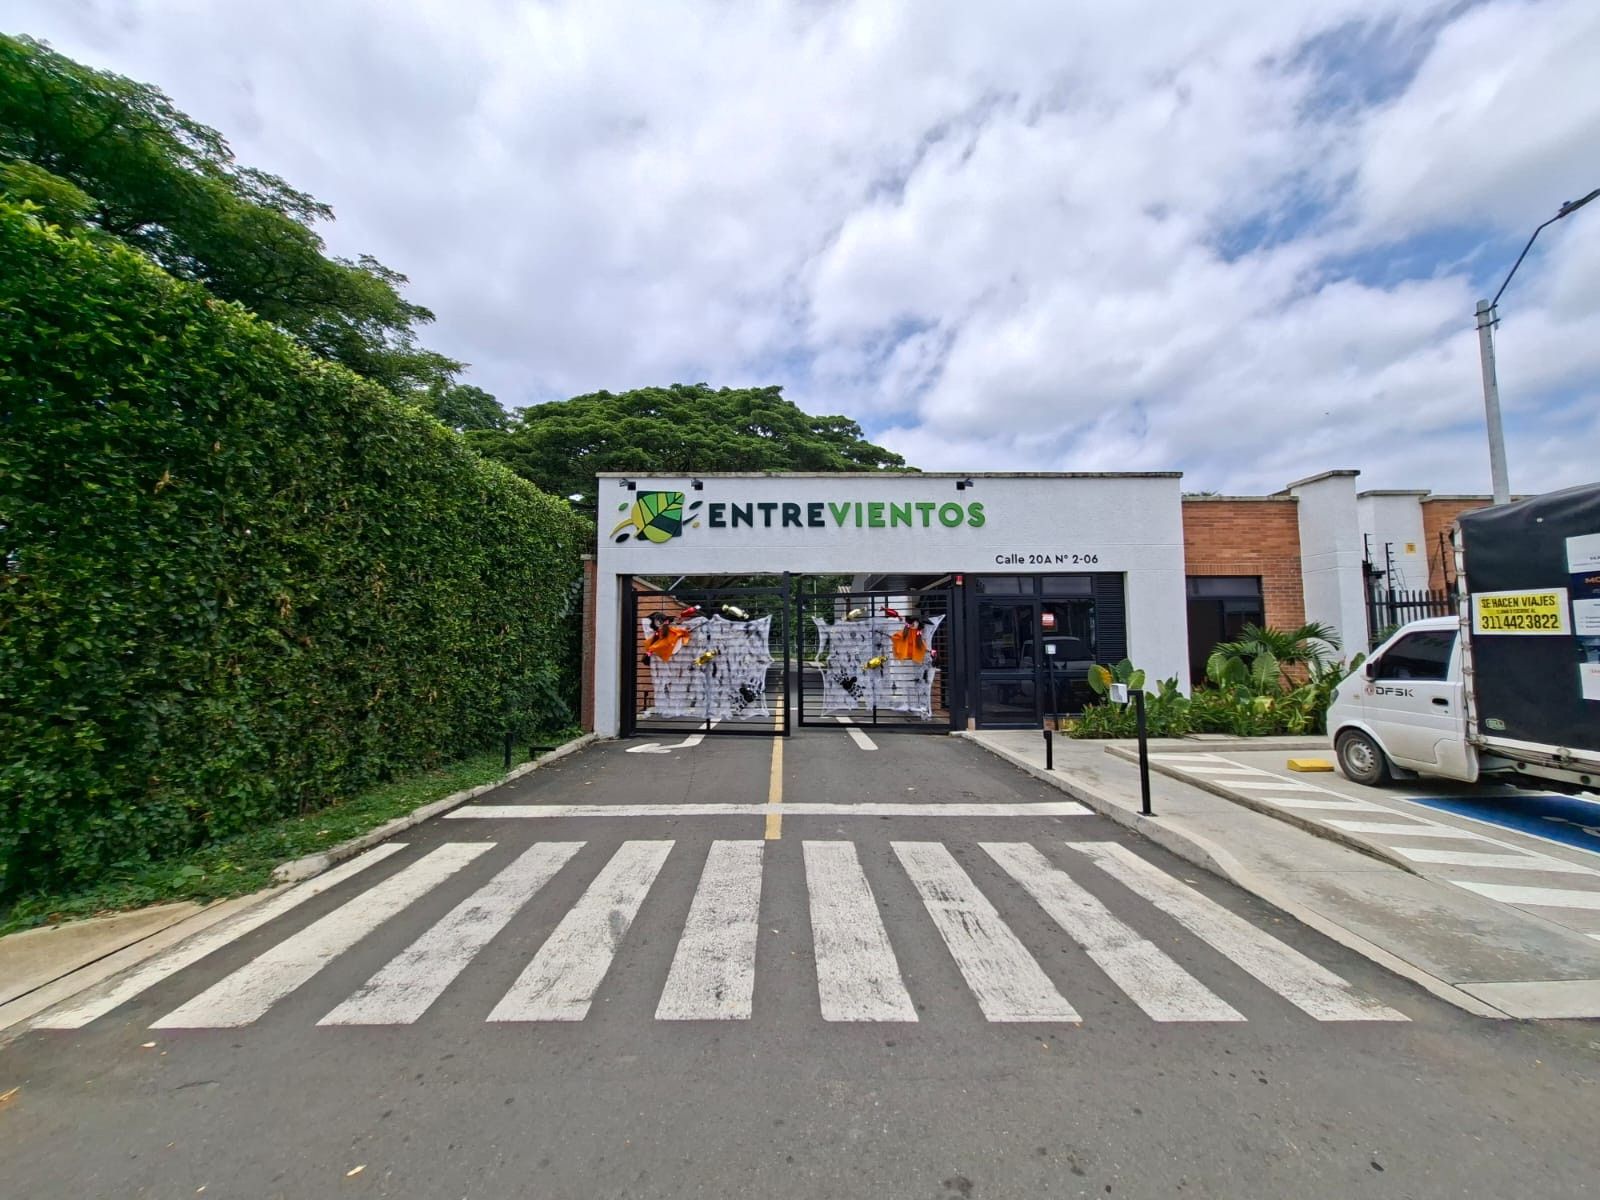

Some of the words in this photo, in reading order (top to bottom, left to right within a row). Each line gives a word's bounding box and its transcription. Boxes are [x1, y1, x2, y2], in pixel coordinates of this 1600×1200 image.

[708, 502, 986, 528] ENTREVIENTOS
[995, 553, 1025, 565] Calle
[1028, 554, 1052, 564] 20A
[1072, 554, 1099, 564] 2-06
[1481, 598, 1492, 608] SE
[1492, 597, 1519, 608] HACEN
[1521, 595, 1556, 607] VIAJES
[1375, 686, 1415, 698] DFSK
